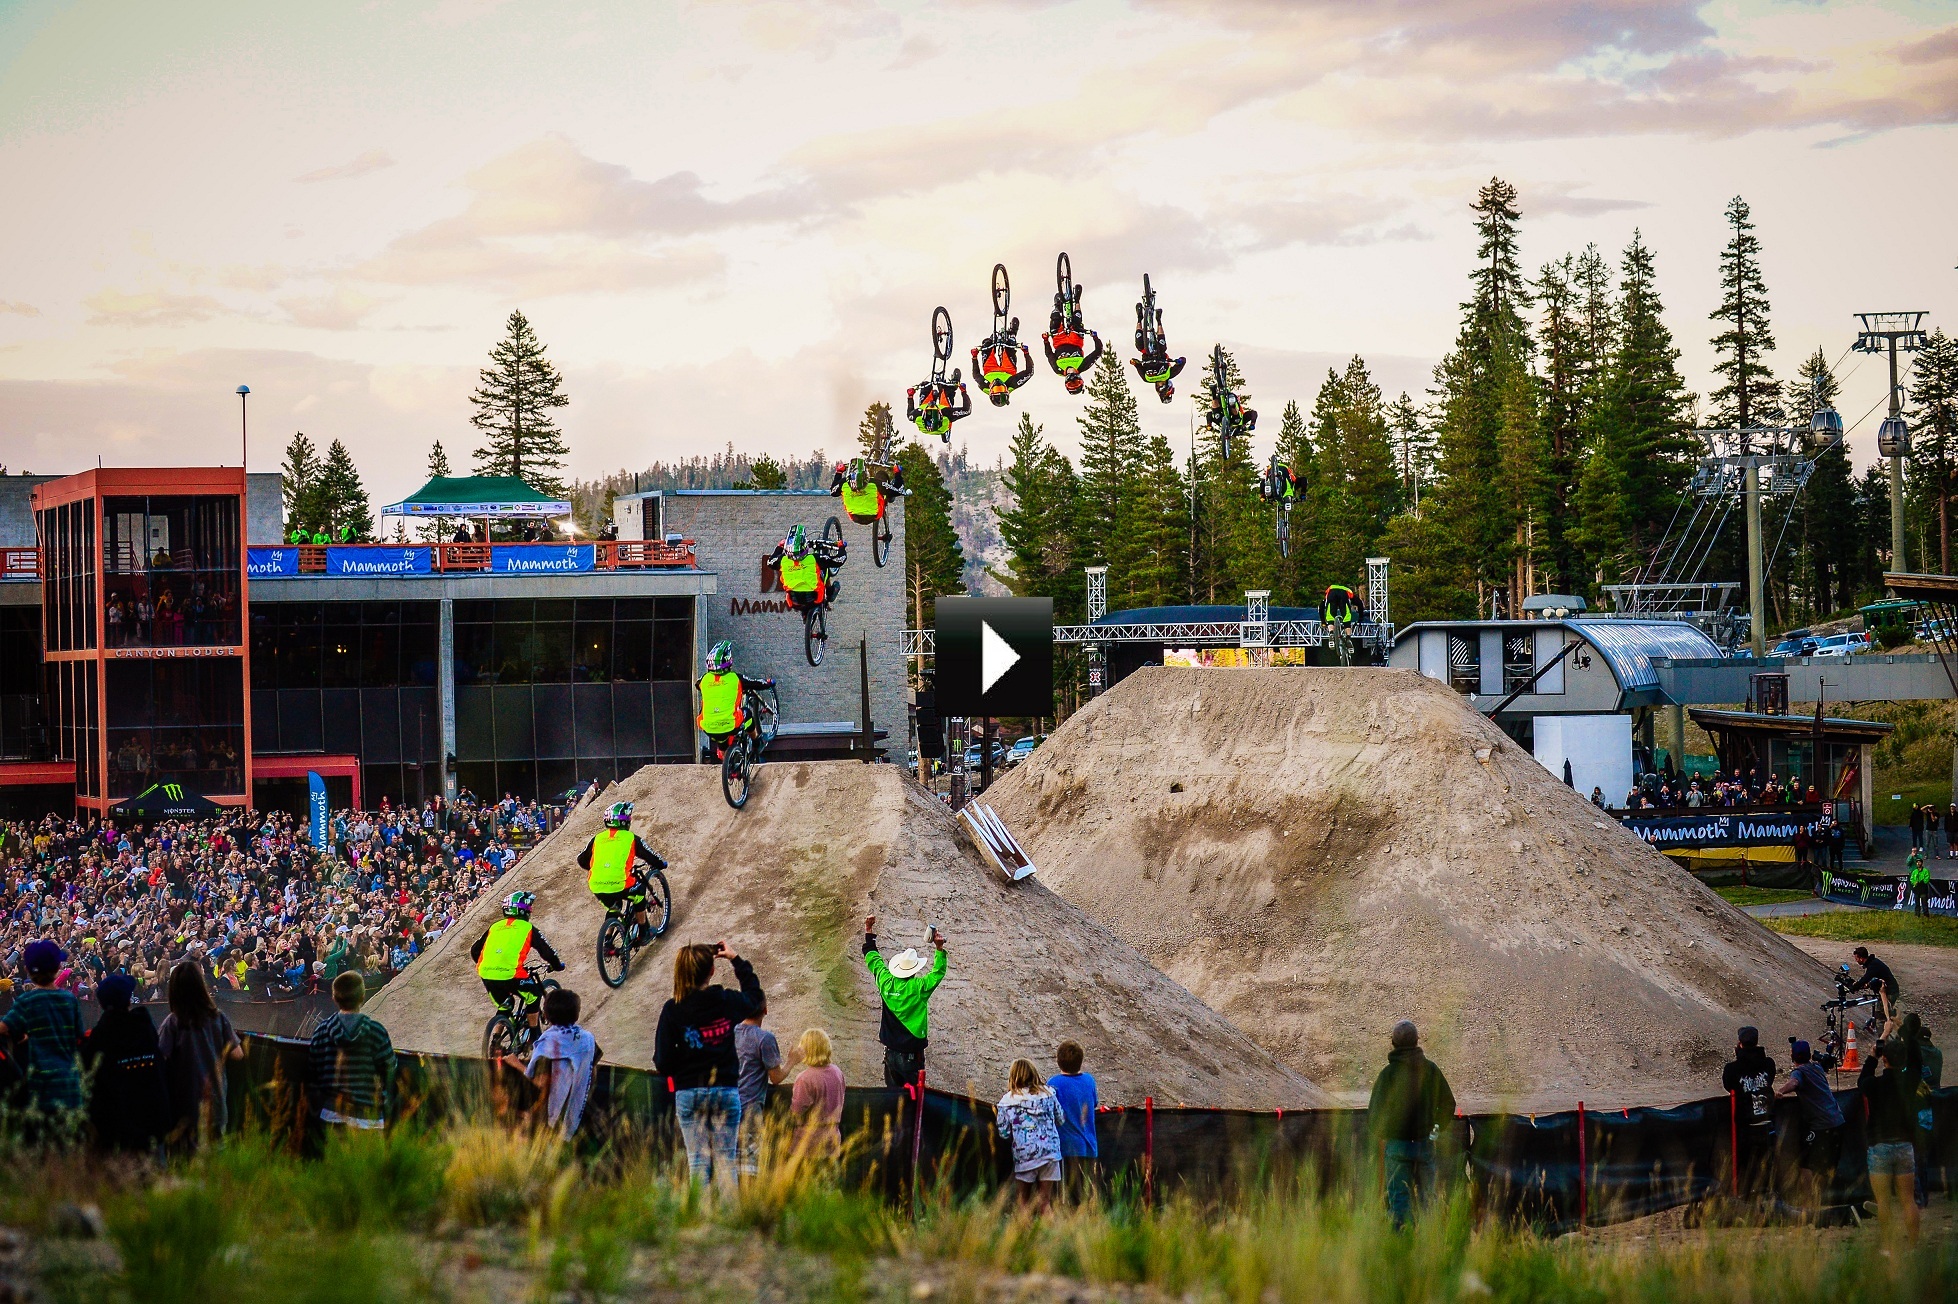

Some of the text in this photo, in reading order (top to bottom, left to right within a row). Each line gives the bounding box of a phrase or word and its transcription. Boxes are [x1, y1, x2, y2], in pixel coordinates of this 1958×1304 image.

[342, 560, 414, 573] Mammoth
[507, 557, 579, 571] Mammoth
[115, 647, 235, 658] CANYON LODGE
[163, 807, 196, 815] MONSTER
[317, 790, 327, 853] Mammoth
[1633, 821, 1819, 842] Mammoth Mammt
